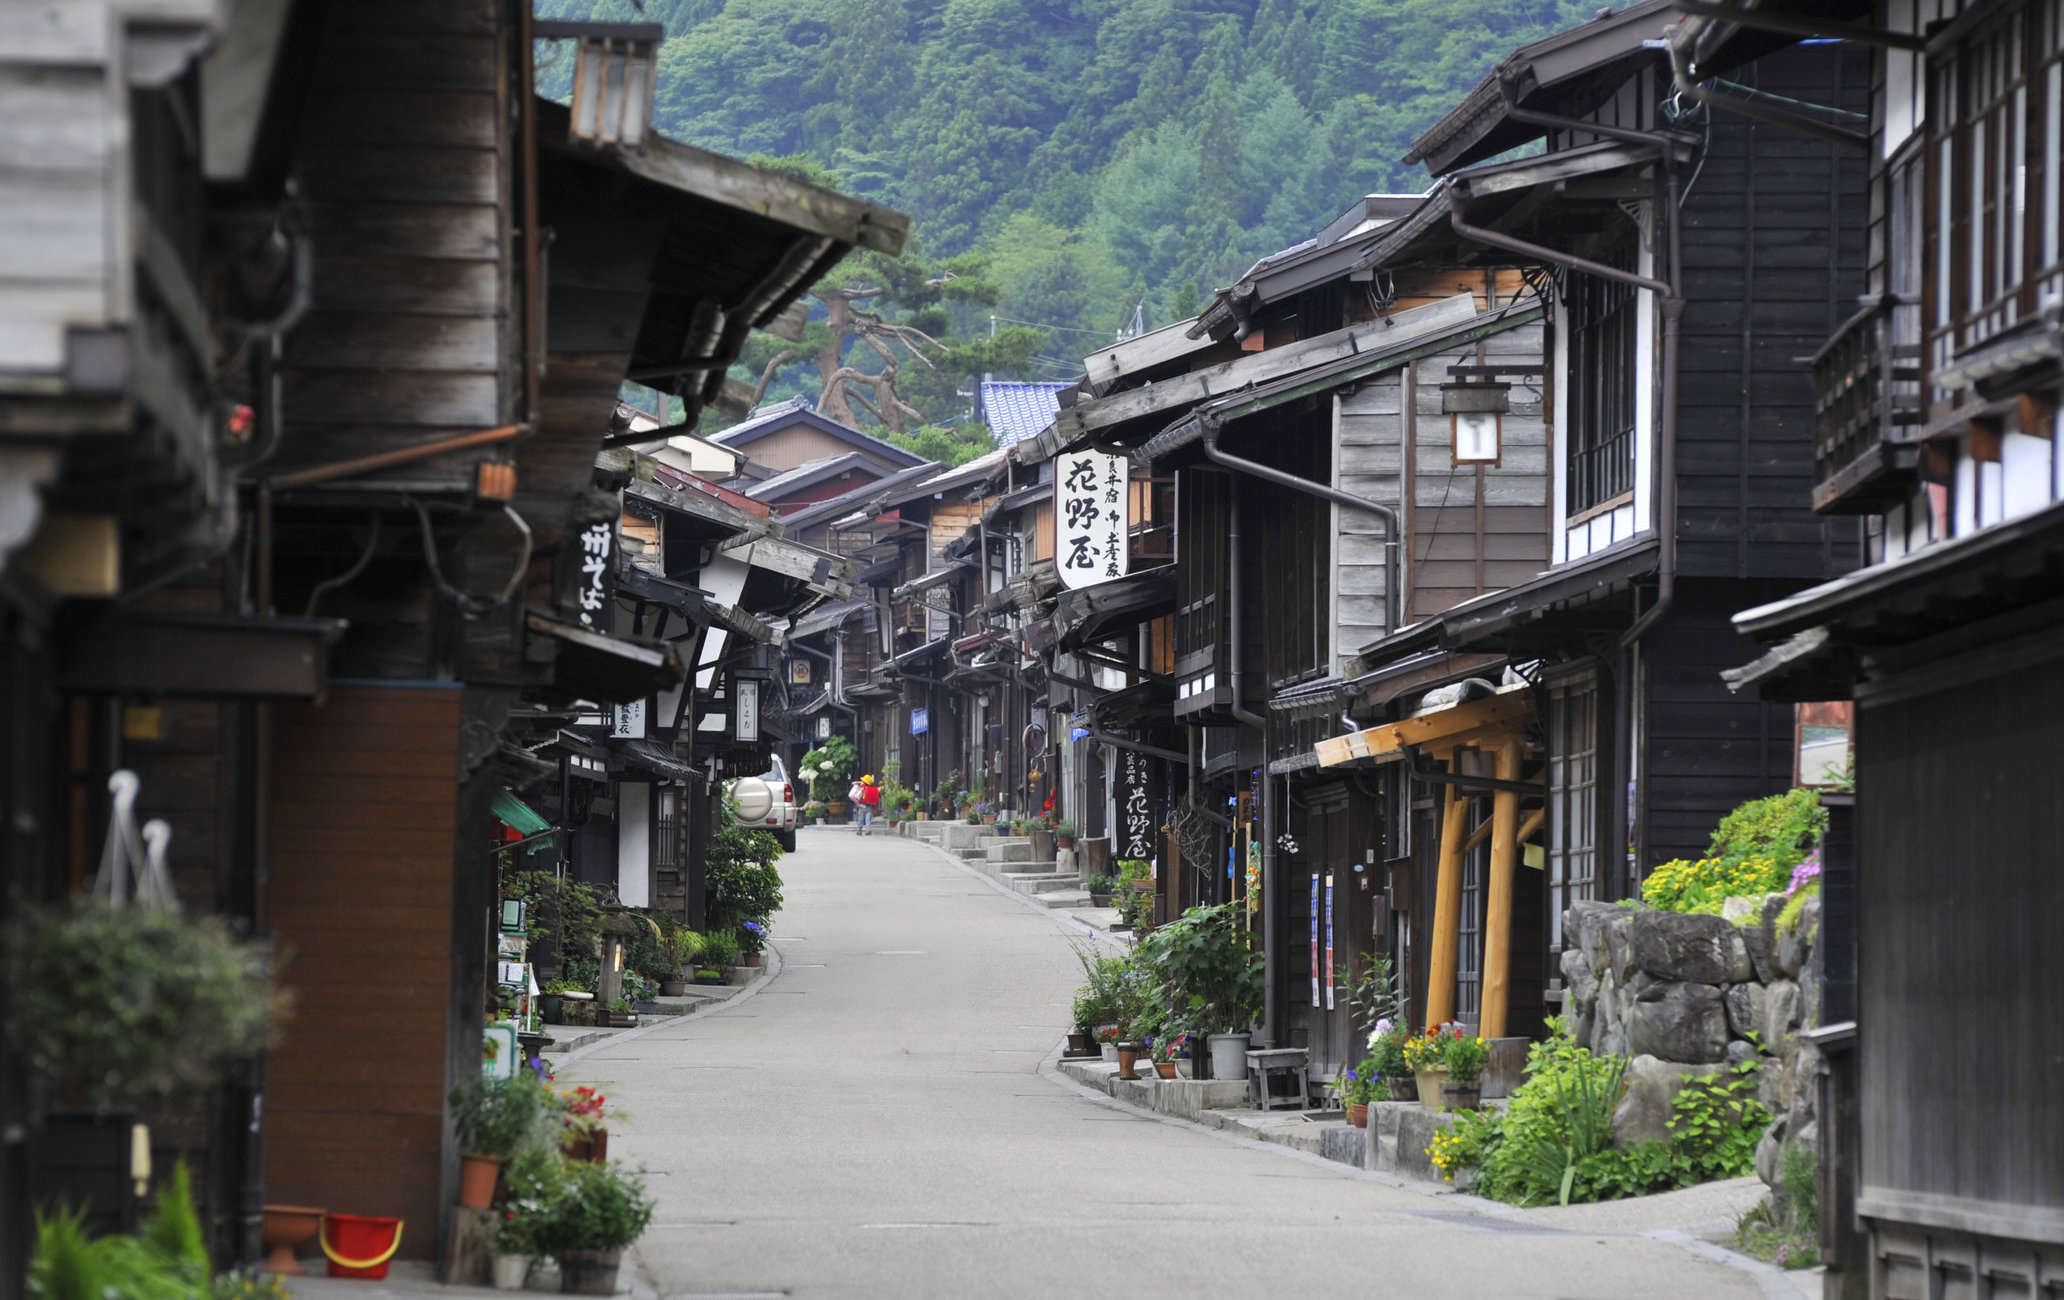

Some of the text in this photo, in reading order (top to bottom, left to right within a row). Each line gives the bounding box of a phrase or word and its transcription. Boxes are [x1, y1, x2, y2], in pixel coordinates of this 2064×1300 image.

[1064, 458, 1100, 570] 花野屋
[579, 522, 612, 634] 州そば
[1124, 752, 1136, 785] 芸品店
[1138, 751, 1149, 784] のき
[1125, 787, 1152, 858] 花野屋
